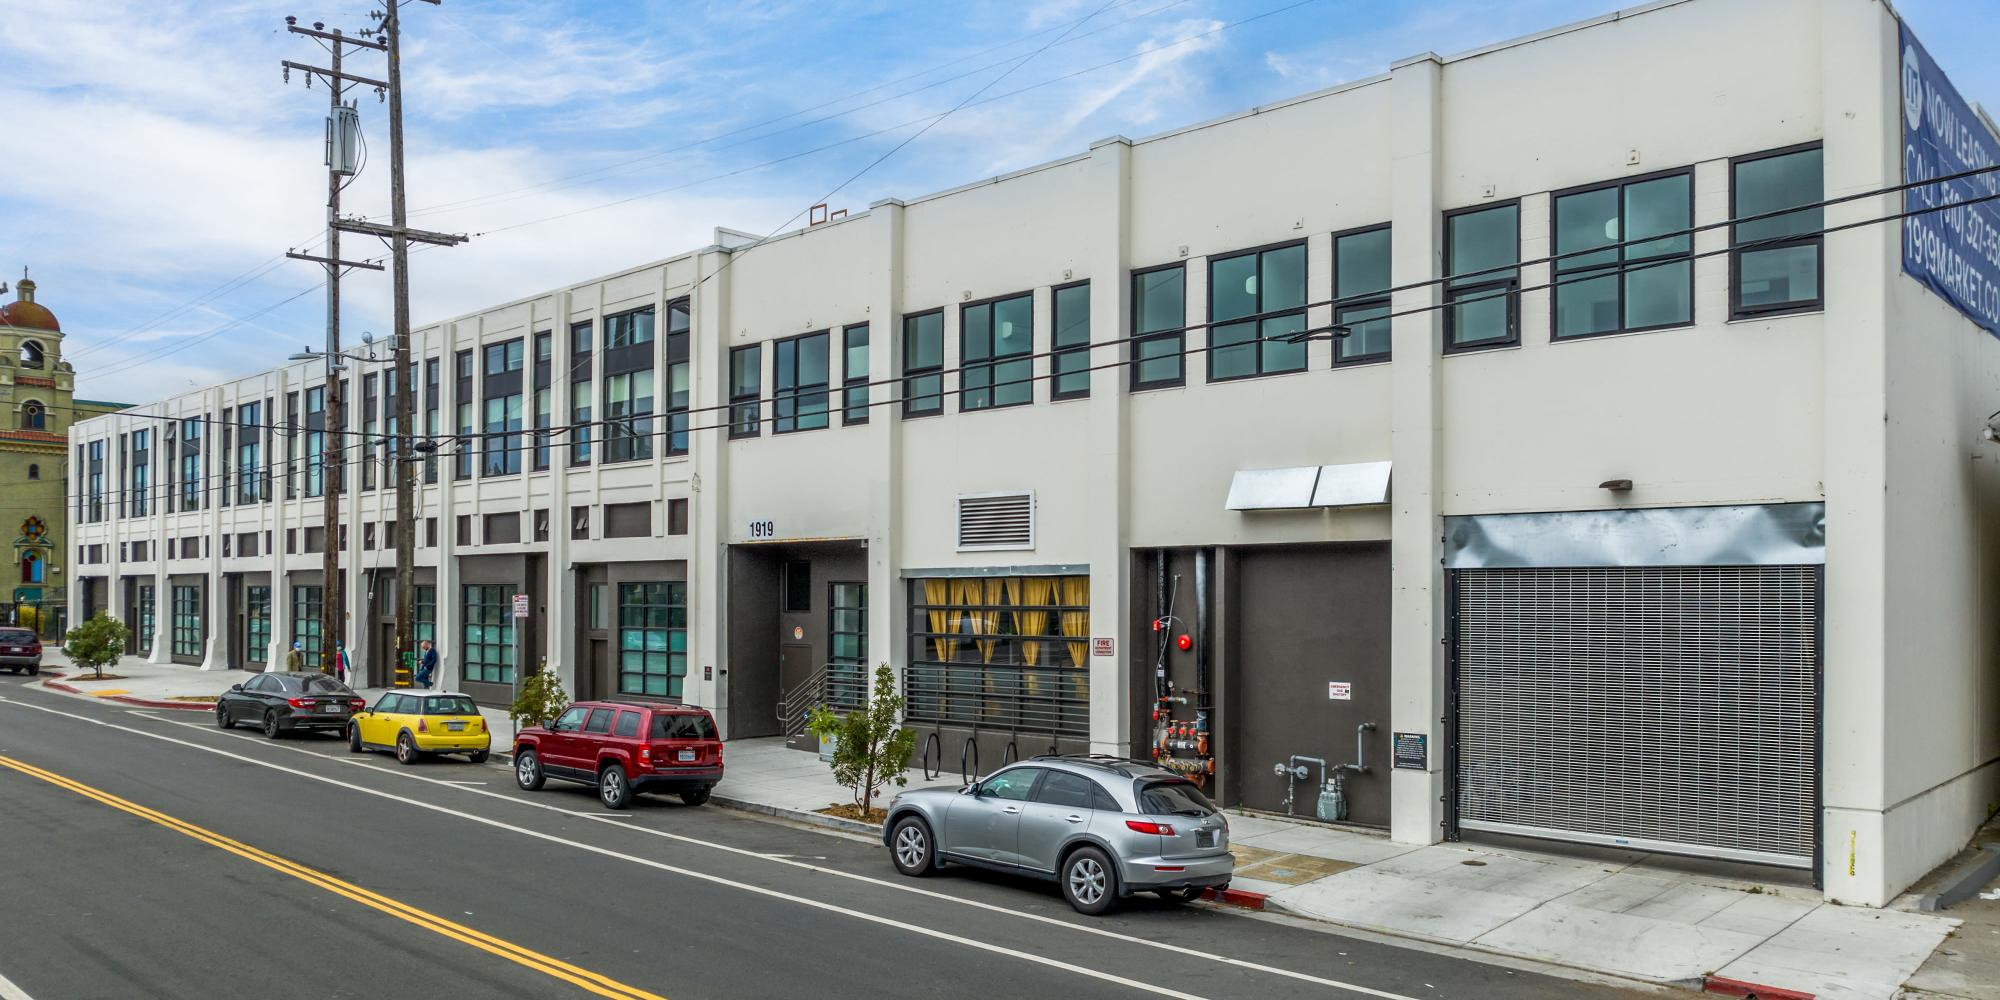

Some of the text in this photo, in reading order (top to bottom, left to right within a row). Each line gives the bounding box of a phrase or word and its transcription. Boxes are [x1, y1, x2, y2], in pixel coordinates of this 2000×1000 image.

[1926, 81, 1996, 196] NOW LEASING
[1906, 144, 1937, 208] CALL
[1940, 180, 1964, 248] (510)
[1906, 215, 1999, 324] 1919MARKET.CO
[750, 521, 774, 537] 1919
